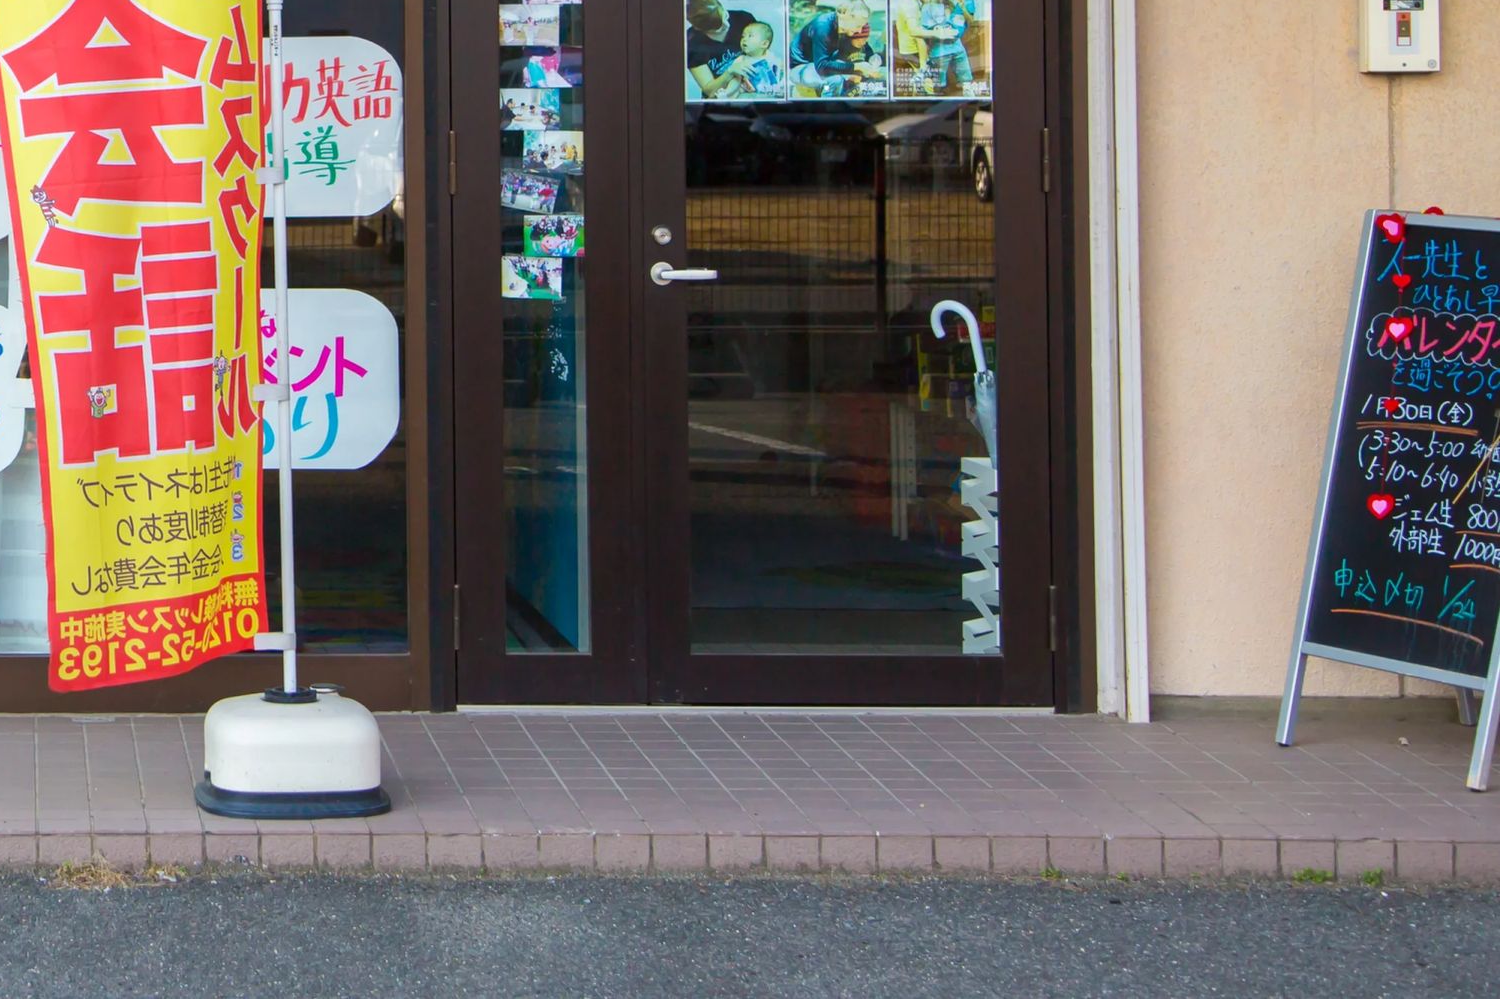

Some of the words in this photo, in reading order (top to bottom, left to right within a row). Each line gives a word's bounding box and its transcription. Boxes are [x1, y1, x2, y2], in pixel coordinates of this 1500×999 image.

[1378, 314, 1500, 362] バレンタ
[1466, 503, 1500, 530] 800
[1389, 521, 1446, 556] 外部生
